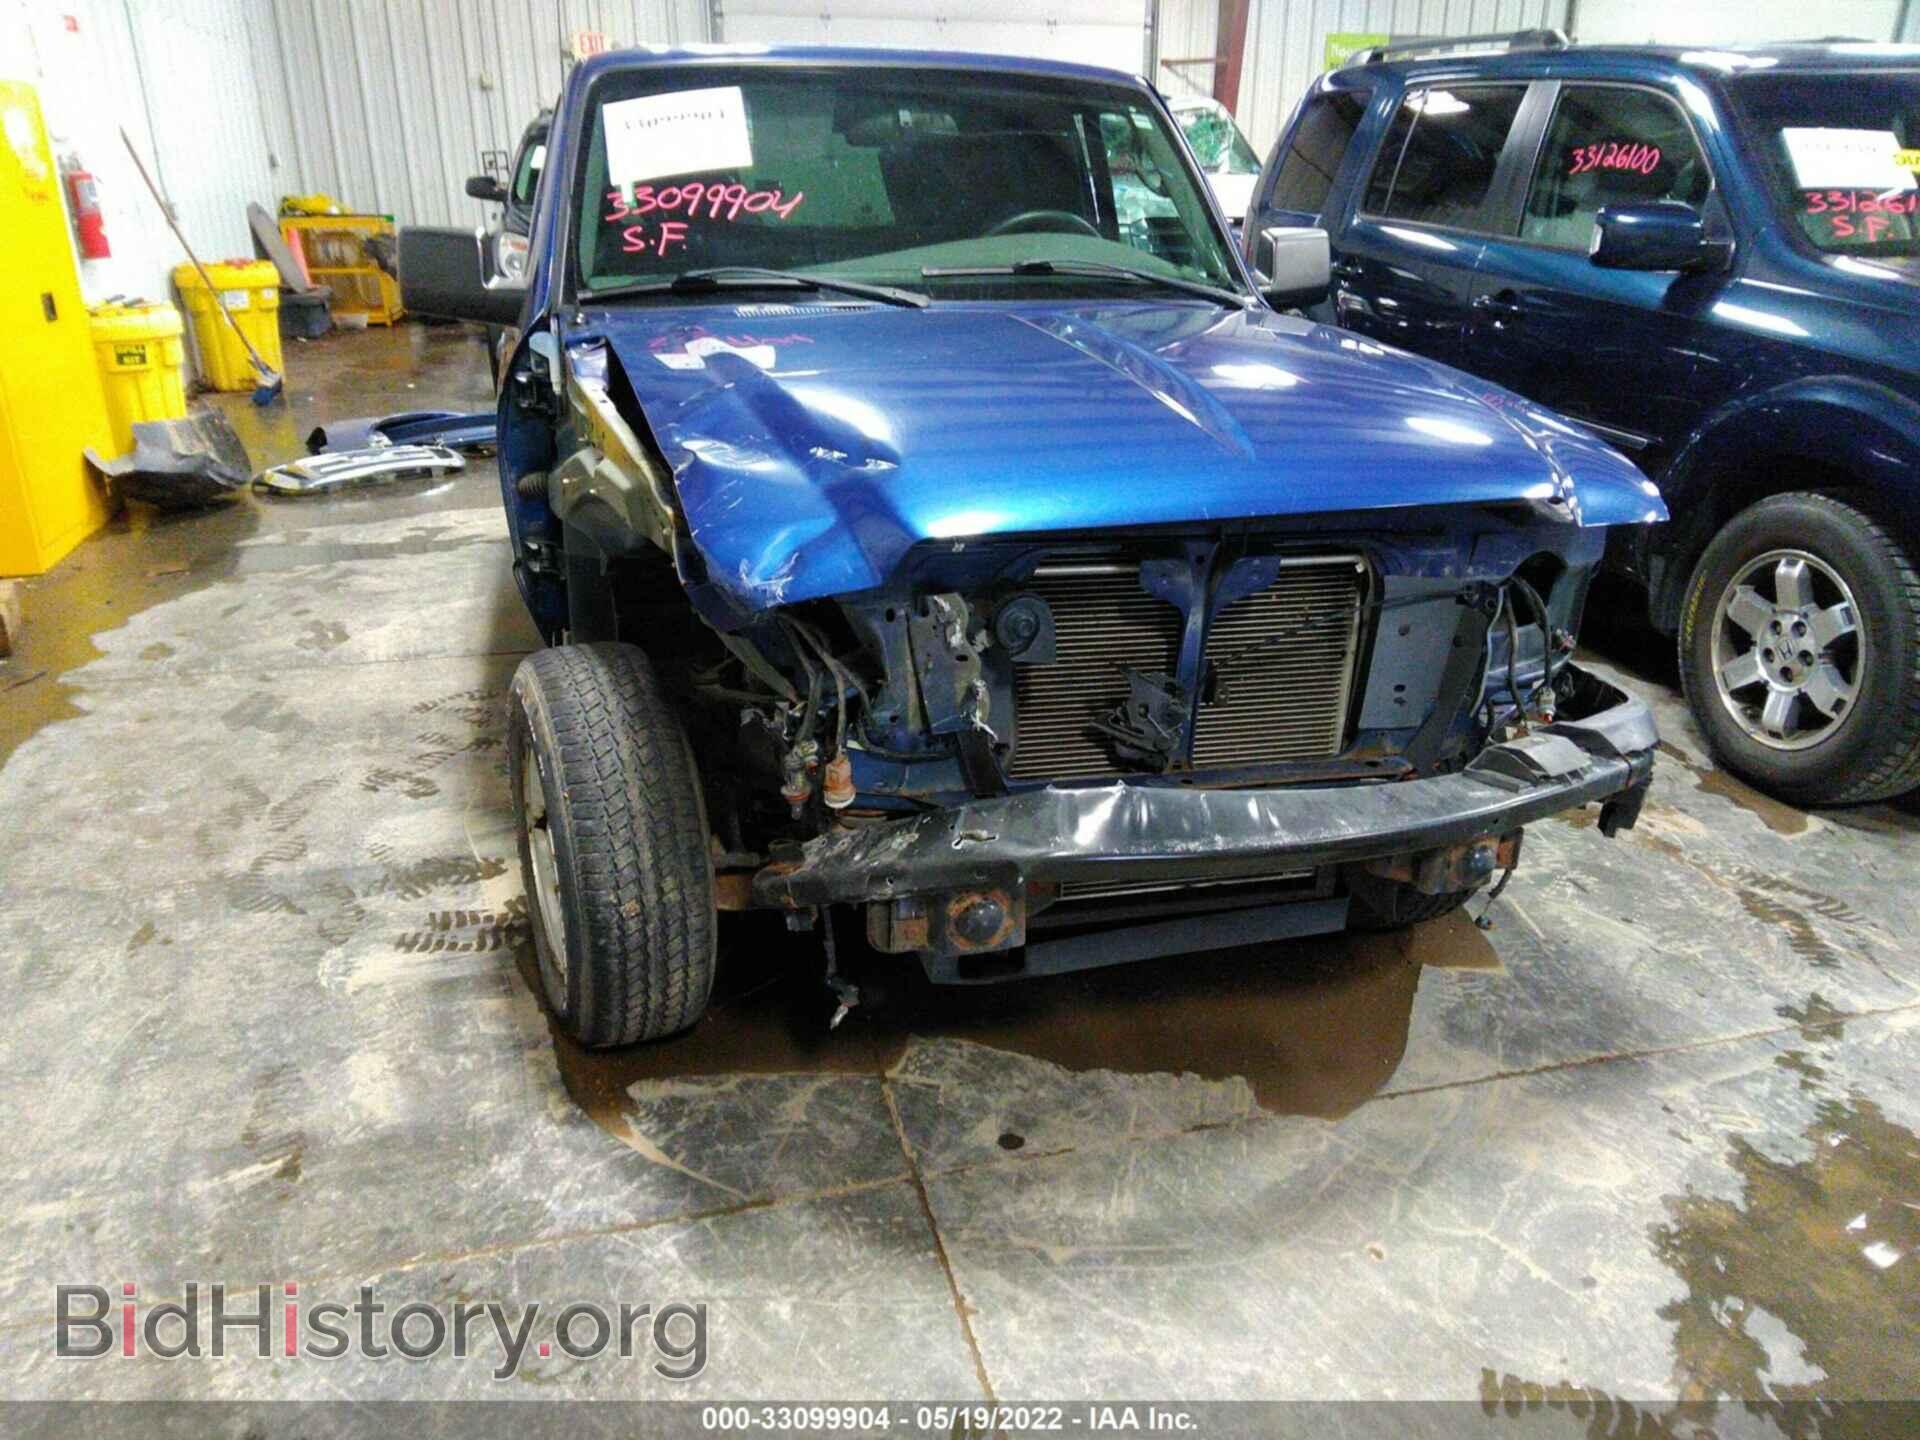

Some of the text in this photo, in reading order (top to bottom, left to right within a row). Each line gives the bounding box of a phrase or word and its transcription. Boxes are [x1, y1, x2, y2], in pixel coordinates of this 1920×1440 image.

[578, 32, 604, 52] EXIT
[1568, 142, 1661, 175] 33126100
[605, 182, 803, 221] 33099904
